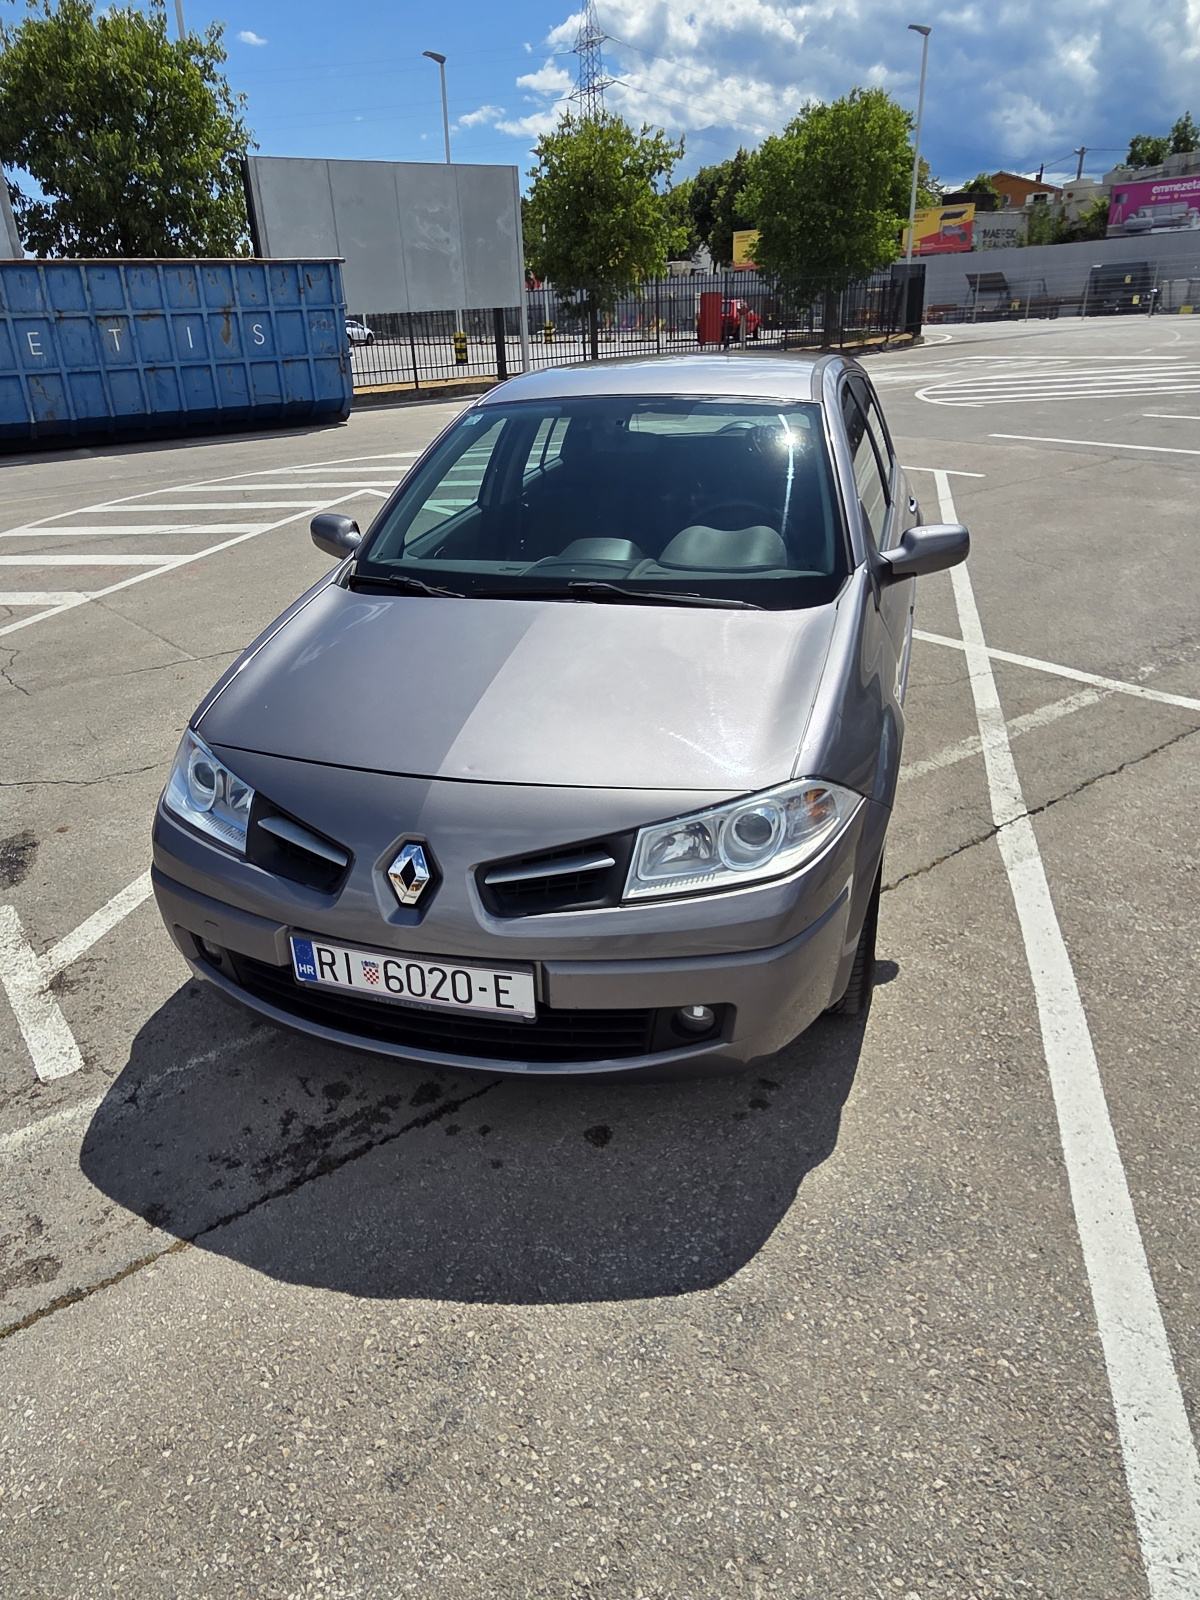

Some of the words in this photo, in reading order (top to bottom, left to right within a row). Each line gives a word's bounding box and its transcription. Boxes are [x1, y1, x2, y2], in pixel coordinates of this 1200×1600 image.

[299, 963, 315, 976] HR
[316, 947, 353, 984] RI
[382, 960, 515, 1009] 6020-E
